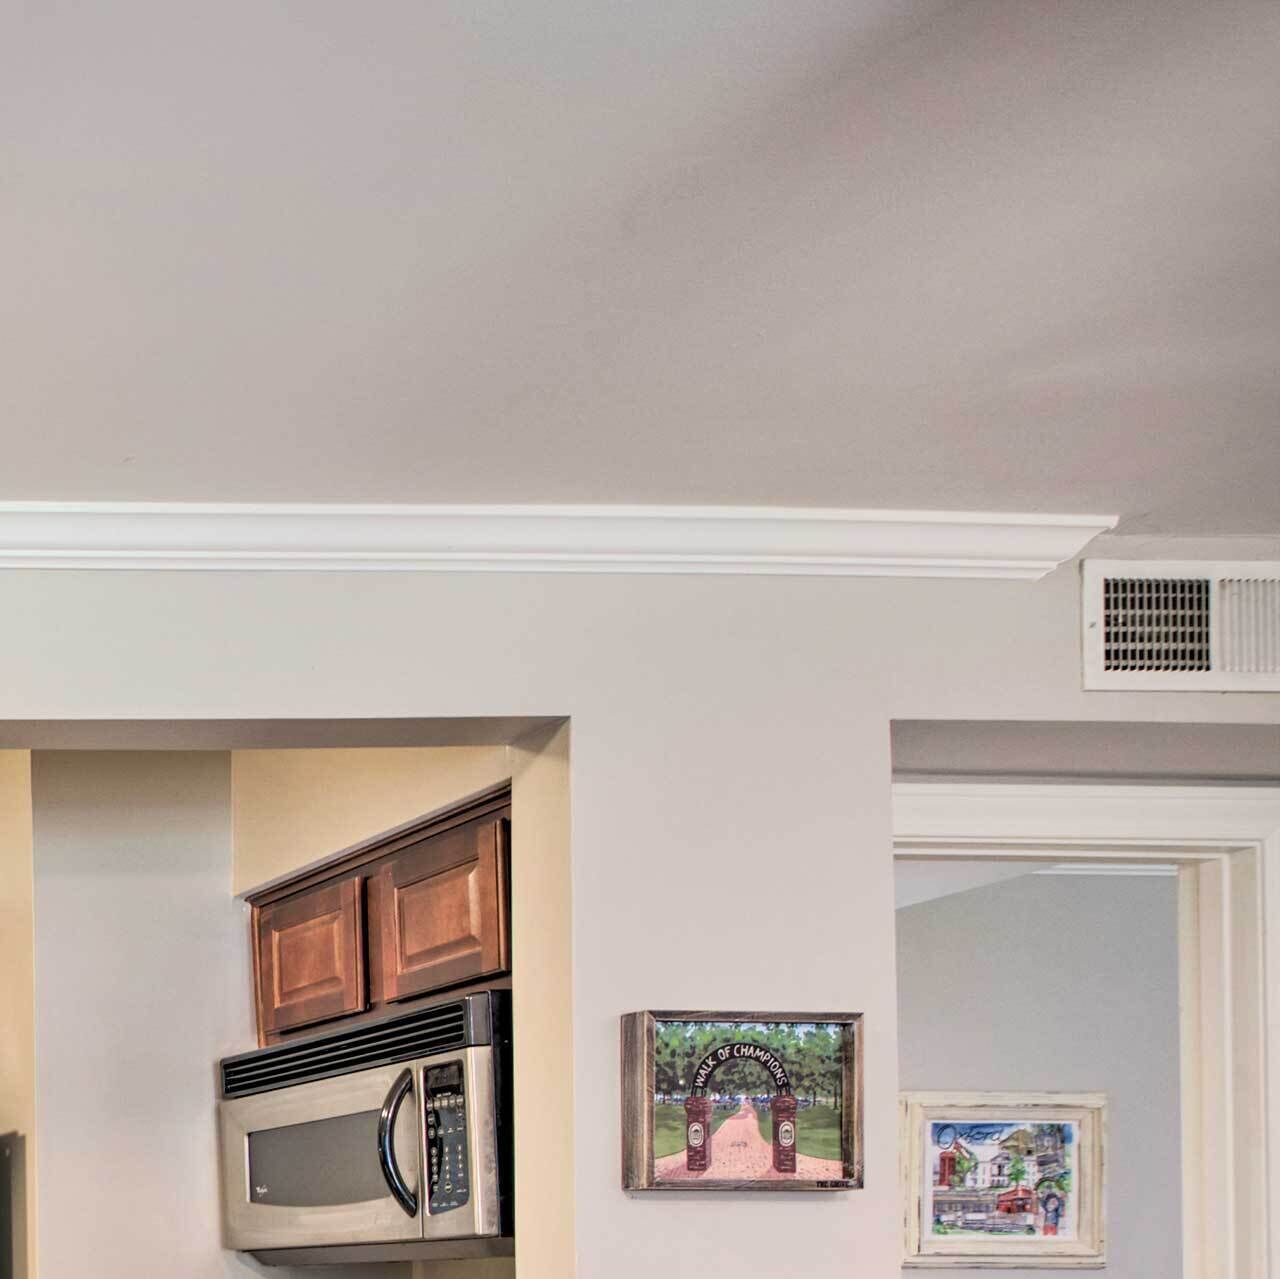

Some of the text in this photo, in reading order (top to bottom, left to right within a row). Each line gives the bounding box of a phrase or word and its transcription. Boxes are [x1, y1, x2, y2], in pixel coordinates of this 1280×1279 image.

[695, 1044, 788, 1087] WALK OF CHAMPIONS
